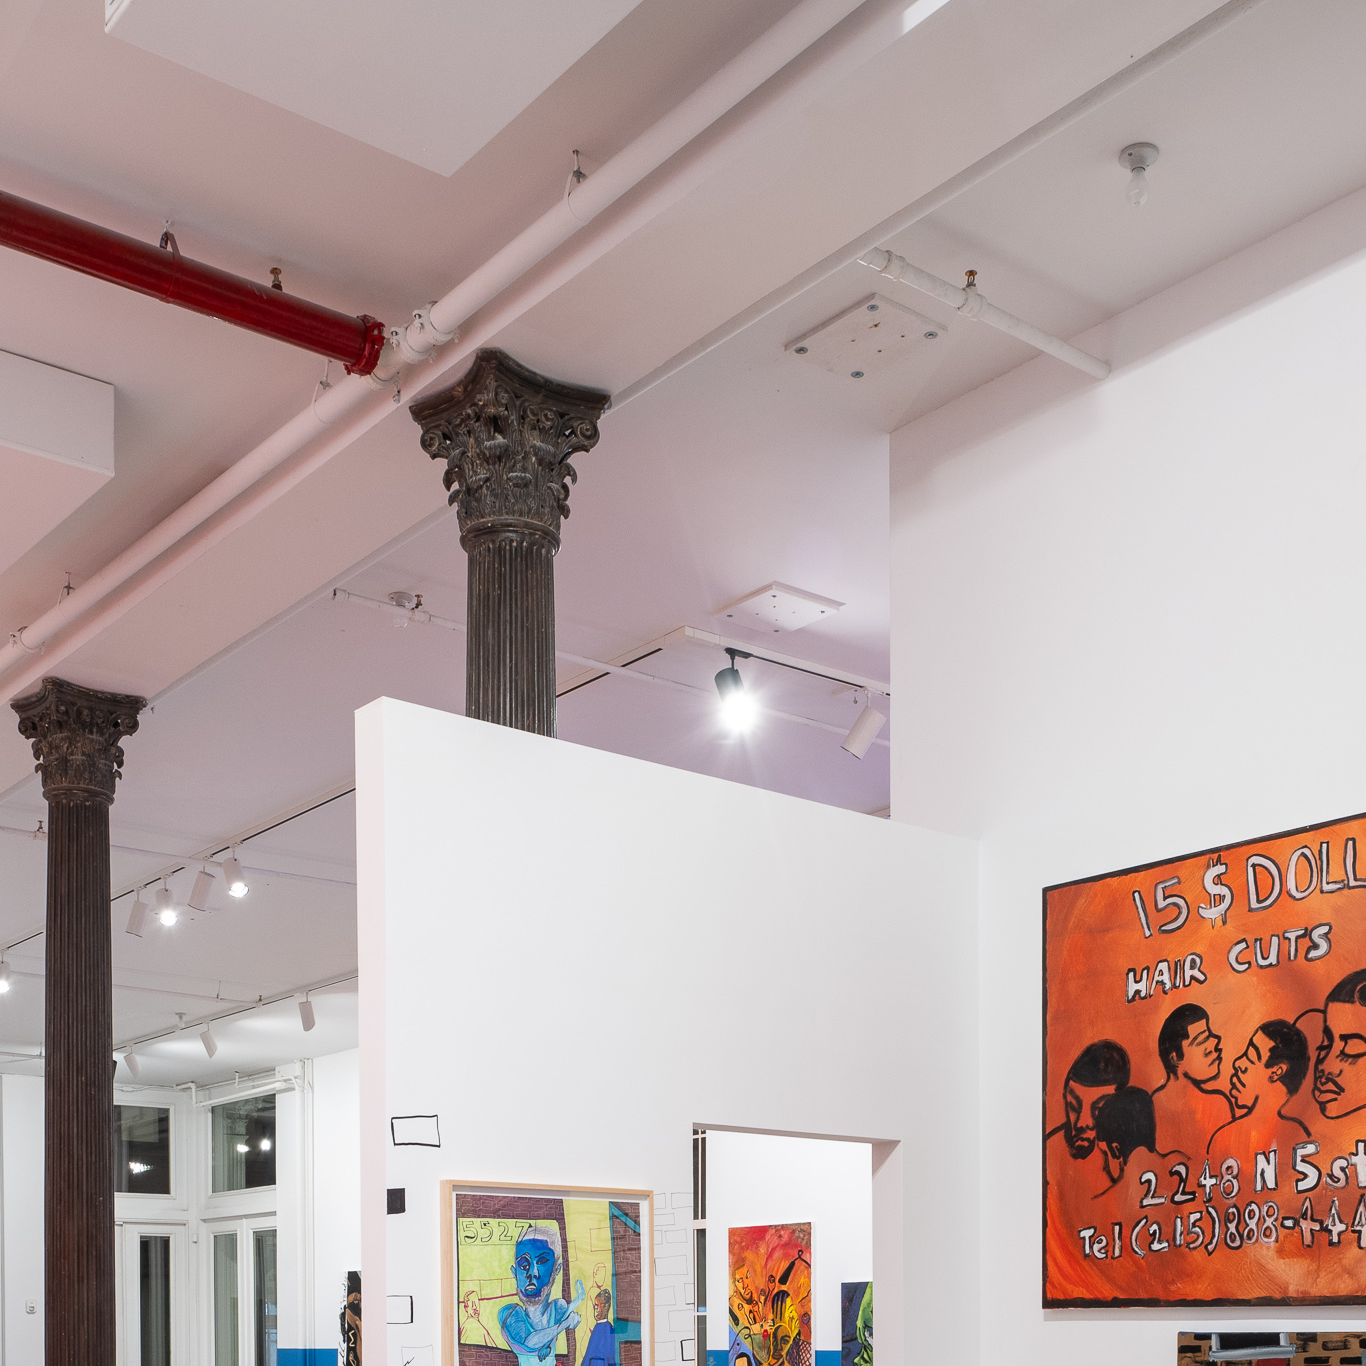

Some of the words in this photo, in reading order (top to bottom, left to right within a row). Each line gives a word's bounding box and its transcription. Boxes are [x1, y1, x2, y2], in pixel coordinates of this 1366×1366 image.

[1132, 876, 1190, 938] 15
[1126, 952, 1208, 1004] HAIR
[1227, 922, 1333, 973] CUTS
[1139, 1156, 1241, 1209] 2248
[1254, 1149, 1279, 1192] N
[461, 1220, 533, 1244] 5527
